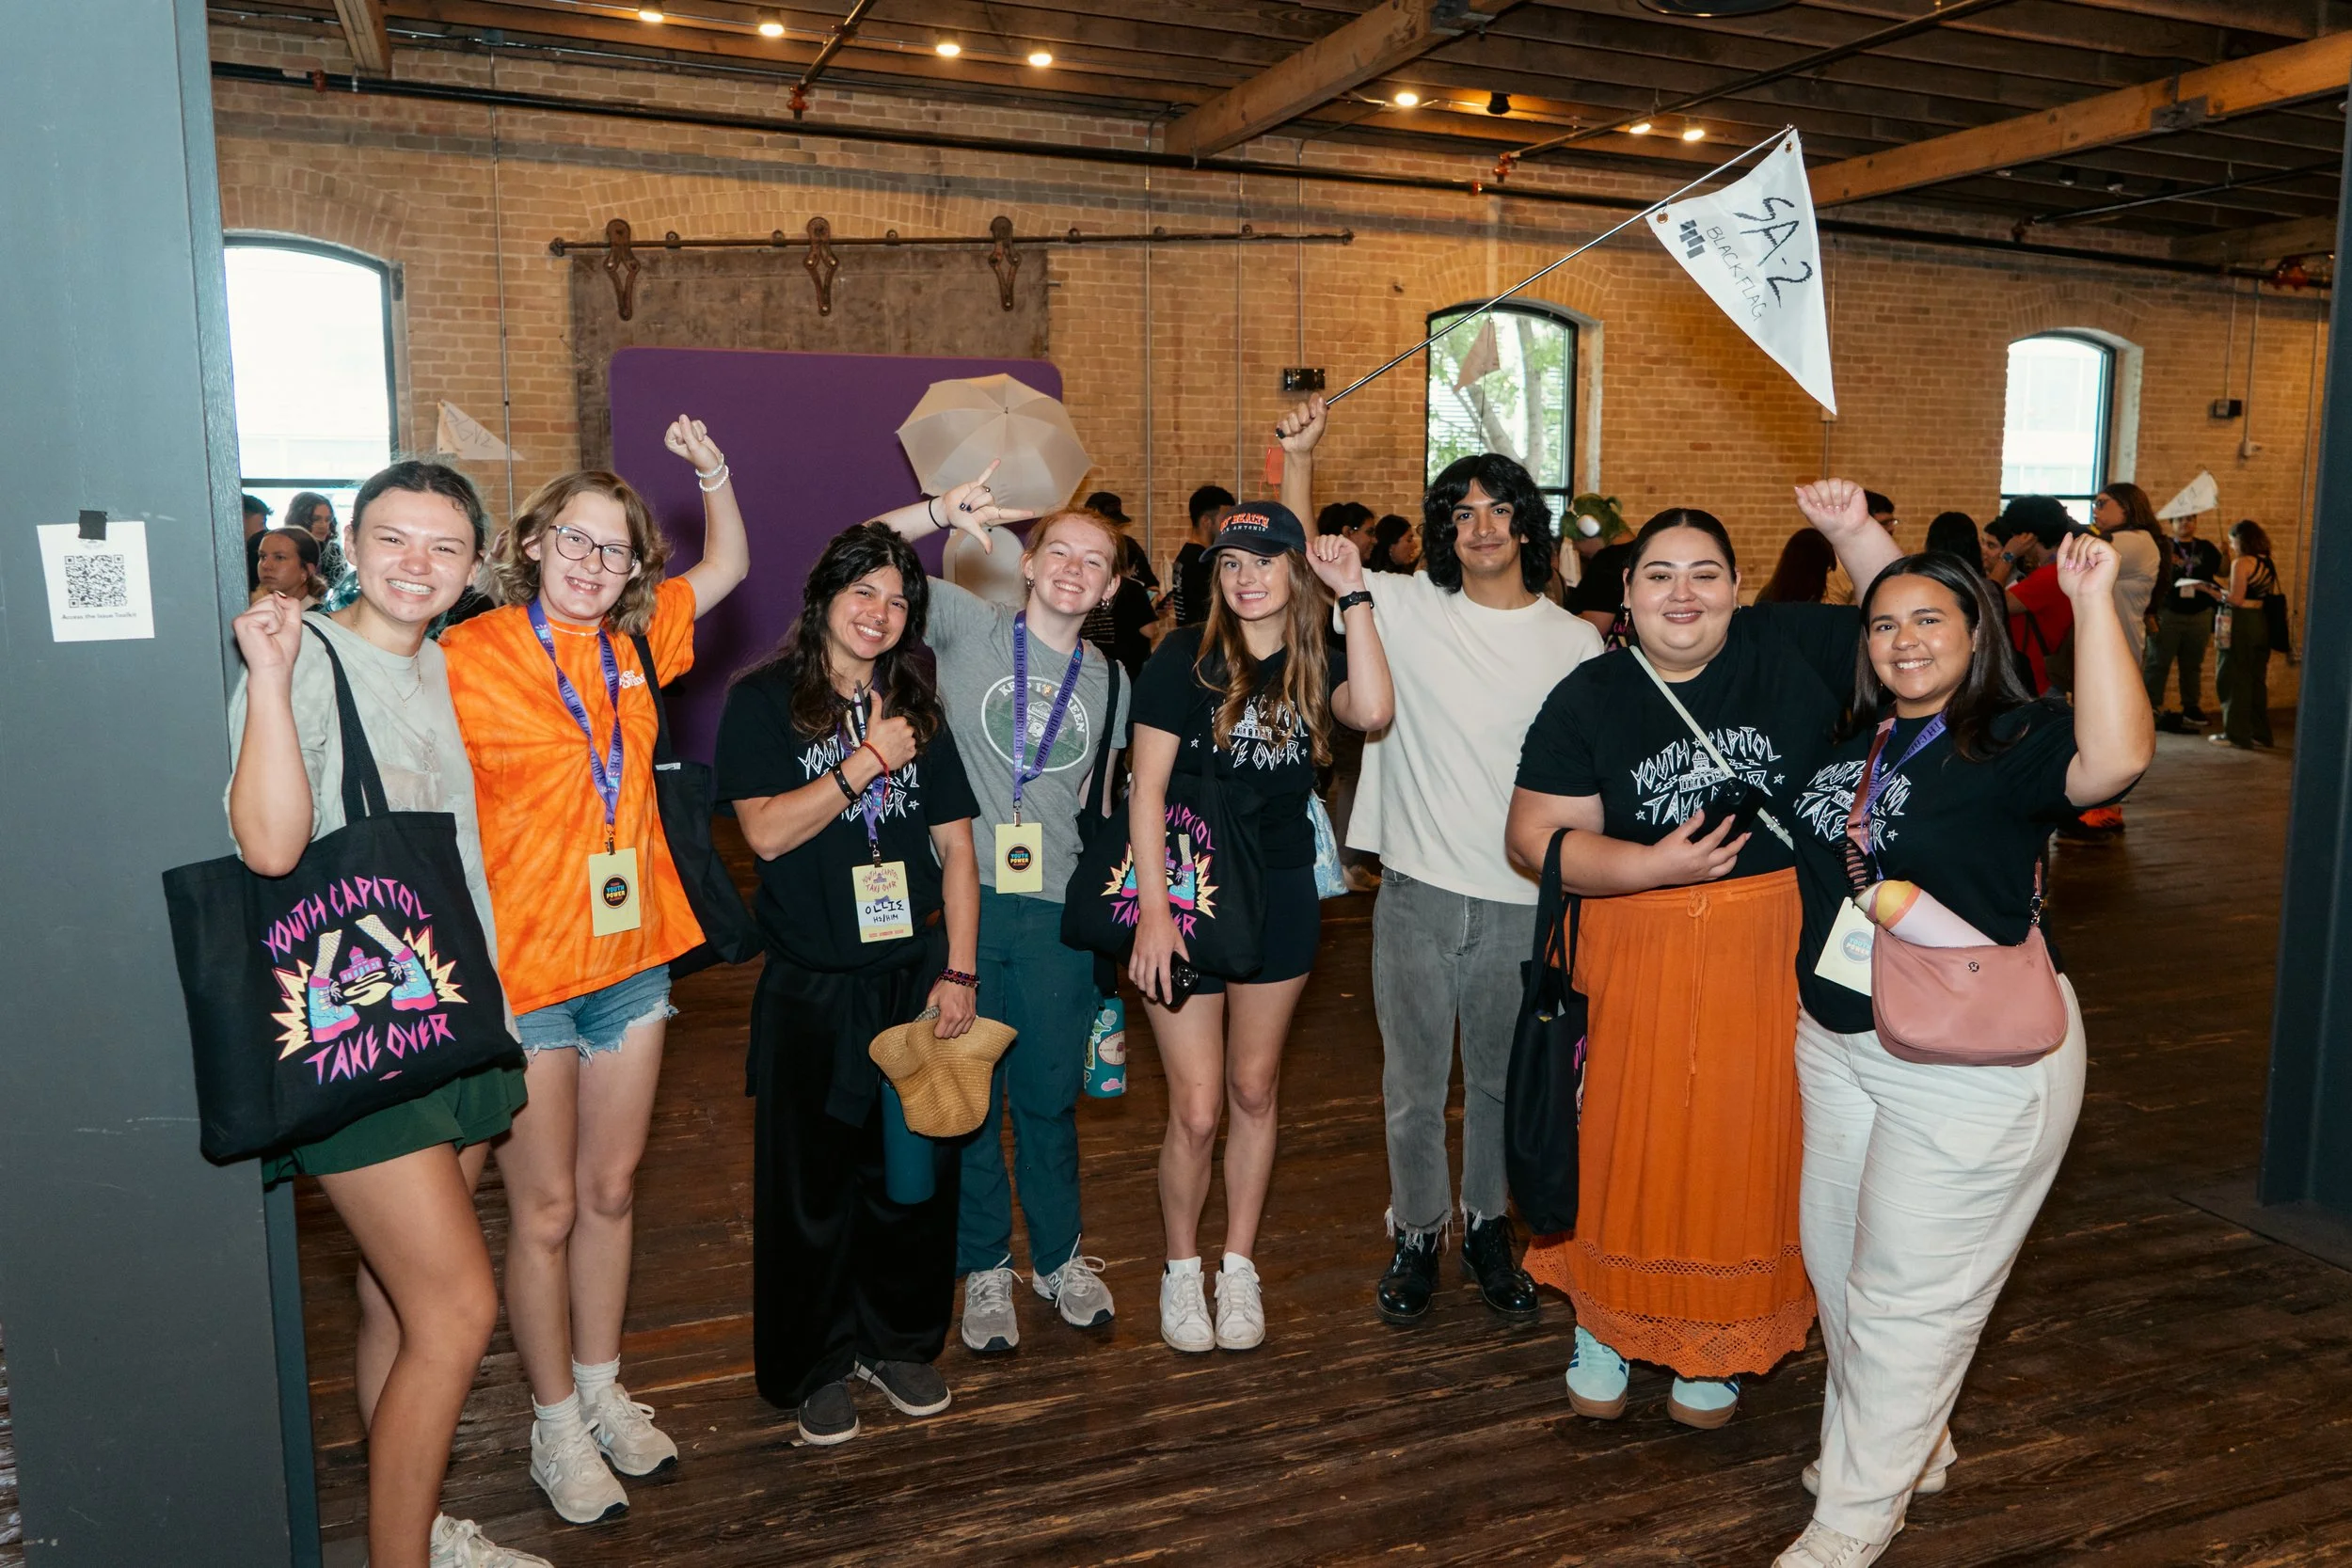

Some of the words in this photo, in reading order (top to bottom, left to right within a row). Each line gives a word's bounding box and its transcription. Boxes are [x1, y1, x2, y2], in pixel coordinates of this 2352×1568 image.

[1707, 226, 1743, 277] BLACK
[1736, 276, 1767, 322] FLAG
[1016, 631, 1025, 663] YOUTH
[1016, 663, 1025, 700] CAPITOL
[1045, 708, 1063, 743] CAPITOL
[1057, 662, 1080, 707] TAKEOVER
[1016, 702, 1025, 756] TAKEOVER
[1630, 738, 1690, 795] YOUTH
[1796, 792, 1849, 842] TAKE
[261, 894, 327, 963] YOUTH
[329, 875, 433, 921] CAPITOL
[865, 900, 904, 914] OLLIE
[303, 1024, 381, 1085] TAKE
[387, 1013, 456, 1059] OVER
